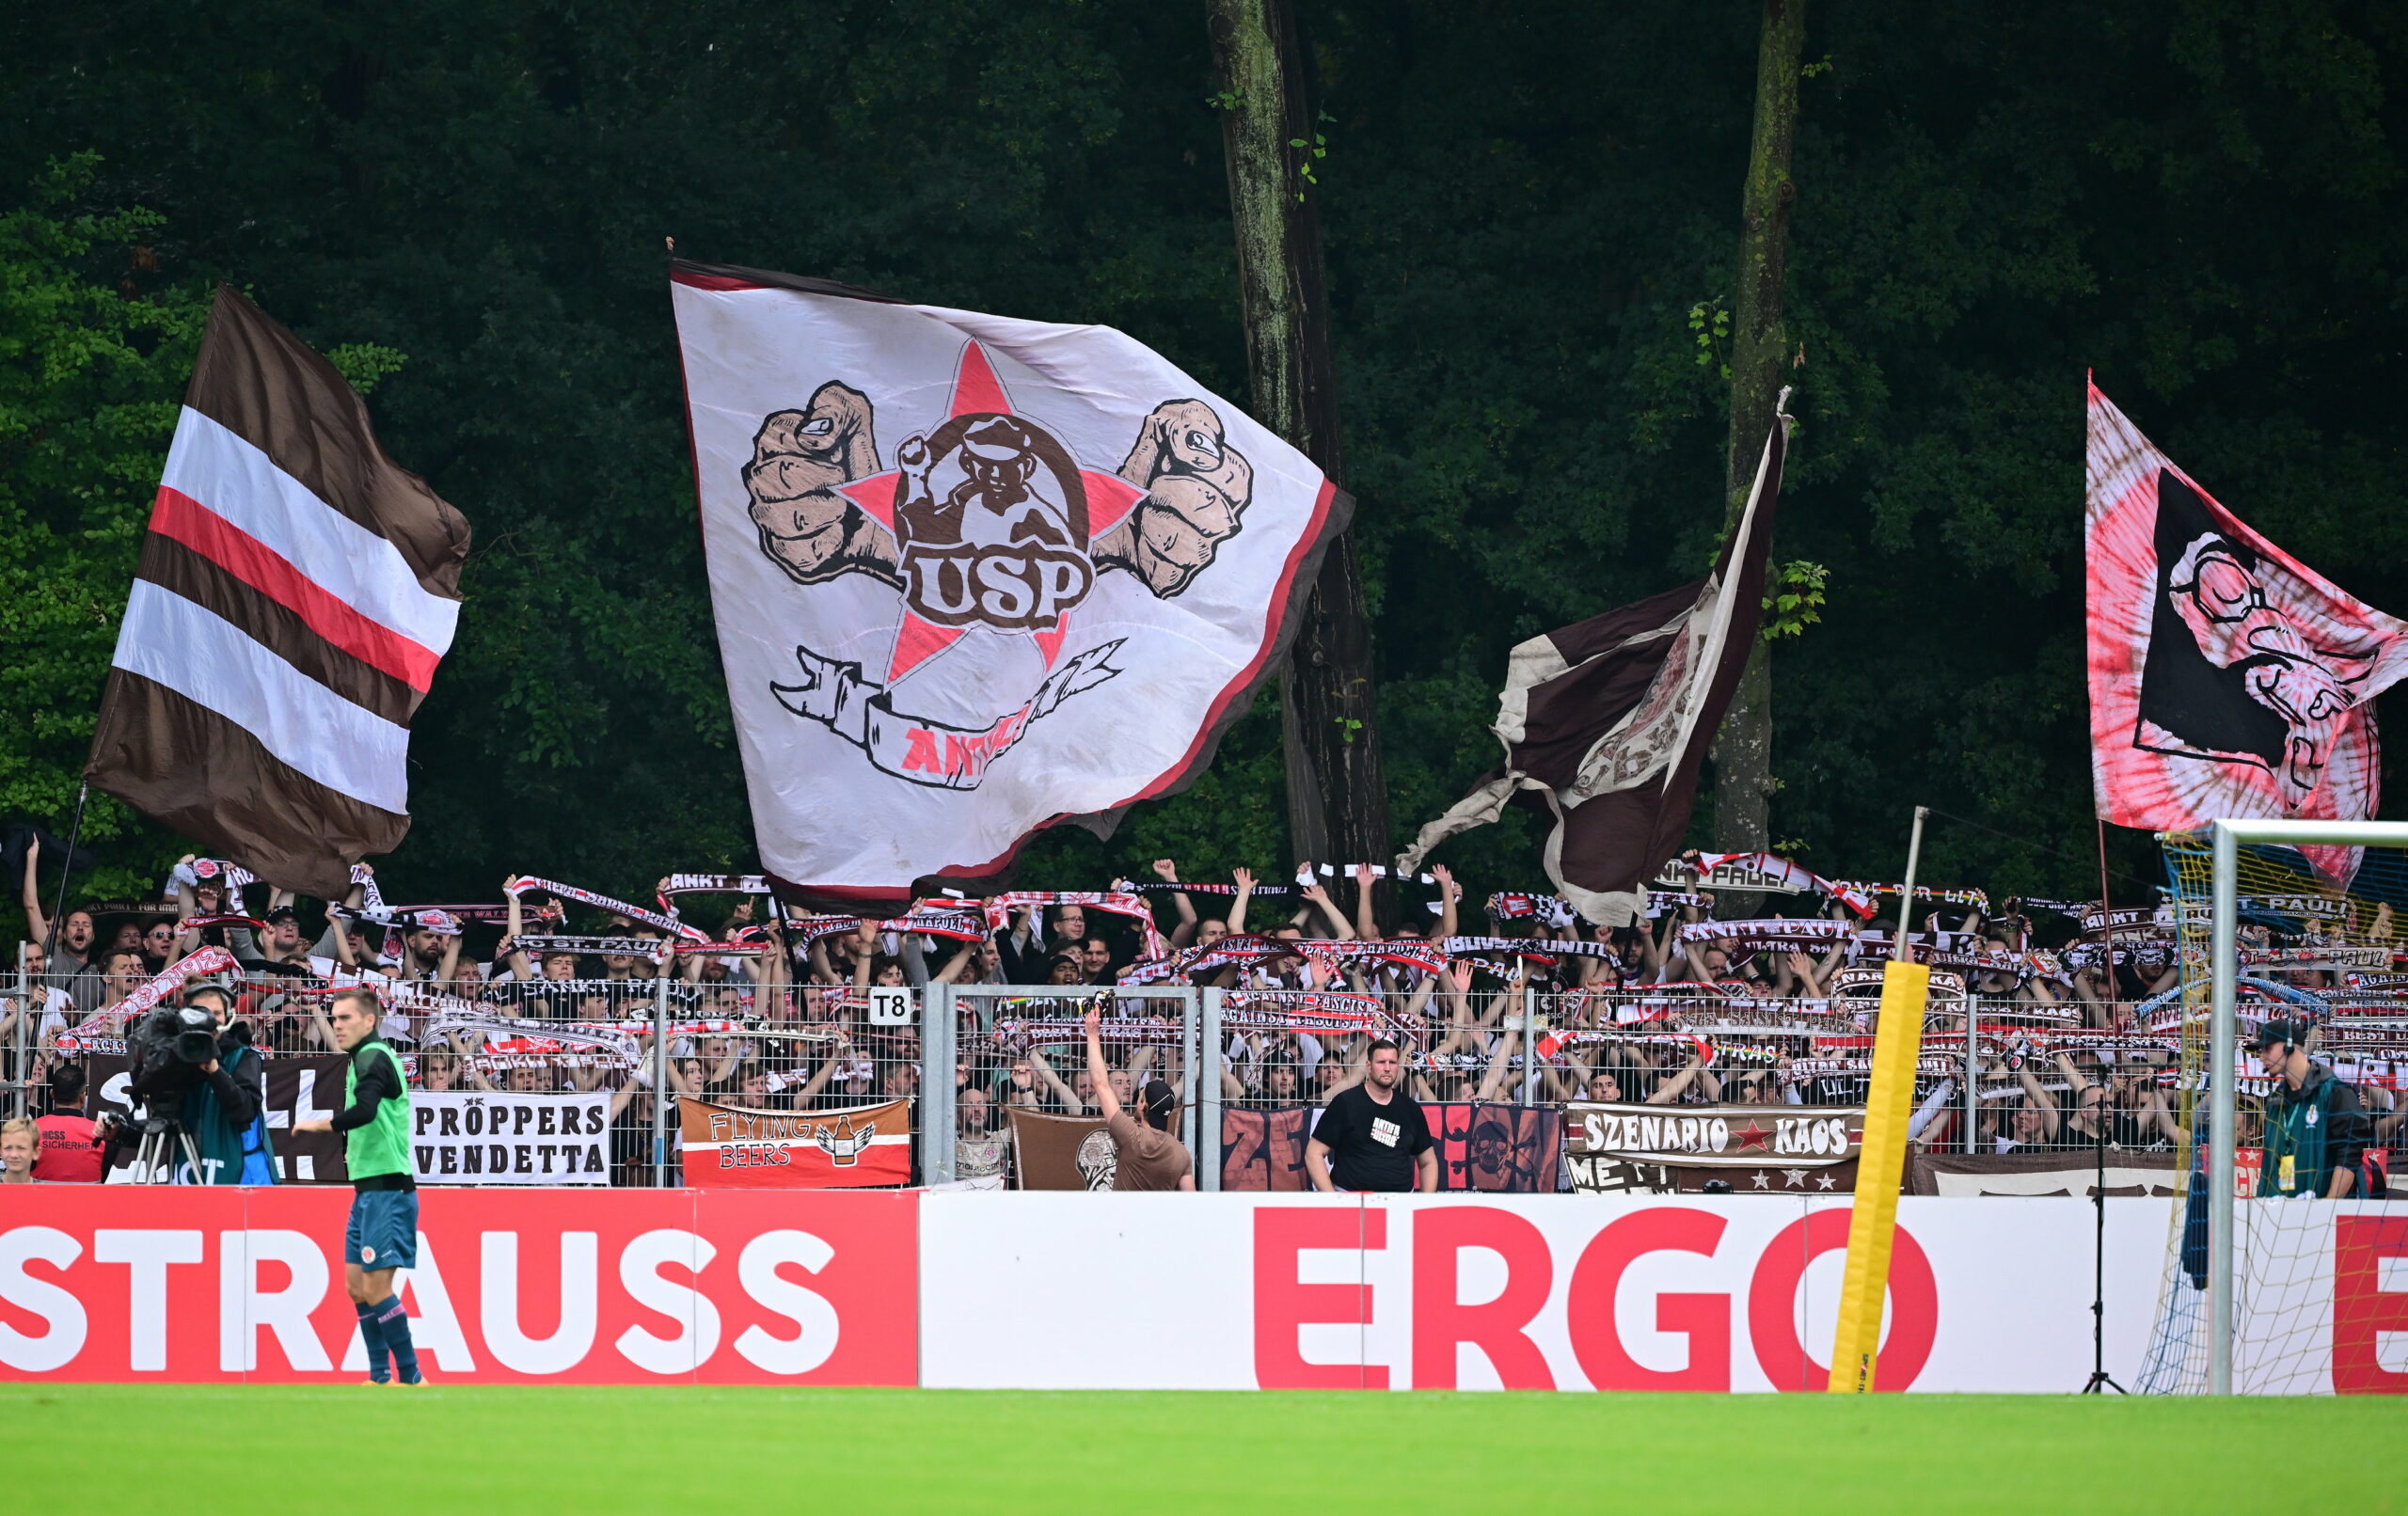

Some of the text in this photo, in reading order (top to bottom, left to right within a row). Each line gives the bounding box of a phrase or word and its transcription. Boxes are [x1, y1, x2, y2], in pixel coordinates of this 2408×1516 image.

[914, 555, 1086, 619] USP
[666, 874, 727, 889] ANKT
[2082, 911, 2139, 929] ANKT
[599, 940, 661, 952] PAUL
[874, 995, 906, 1017] T8
[415, 1098, 604, 1136] PRÖPPERS
[708, 1112, 812, 1141] FLYING
[1584, 1113, 1729, 1154] SZENARIO
[1774, 1117, 1847, 1155] KAOS
[415, 1145, 604, 1174] VENDETTA
[720, 1143, 791, 1169] BEERS
[1253, 1205, 1939, 1392] ERGO
